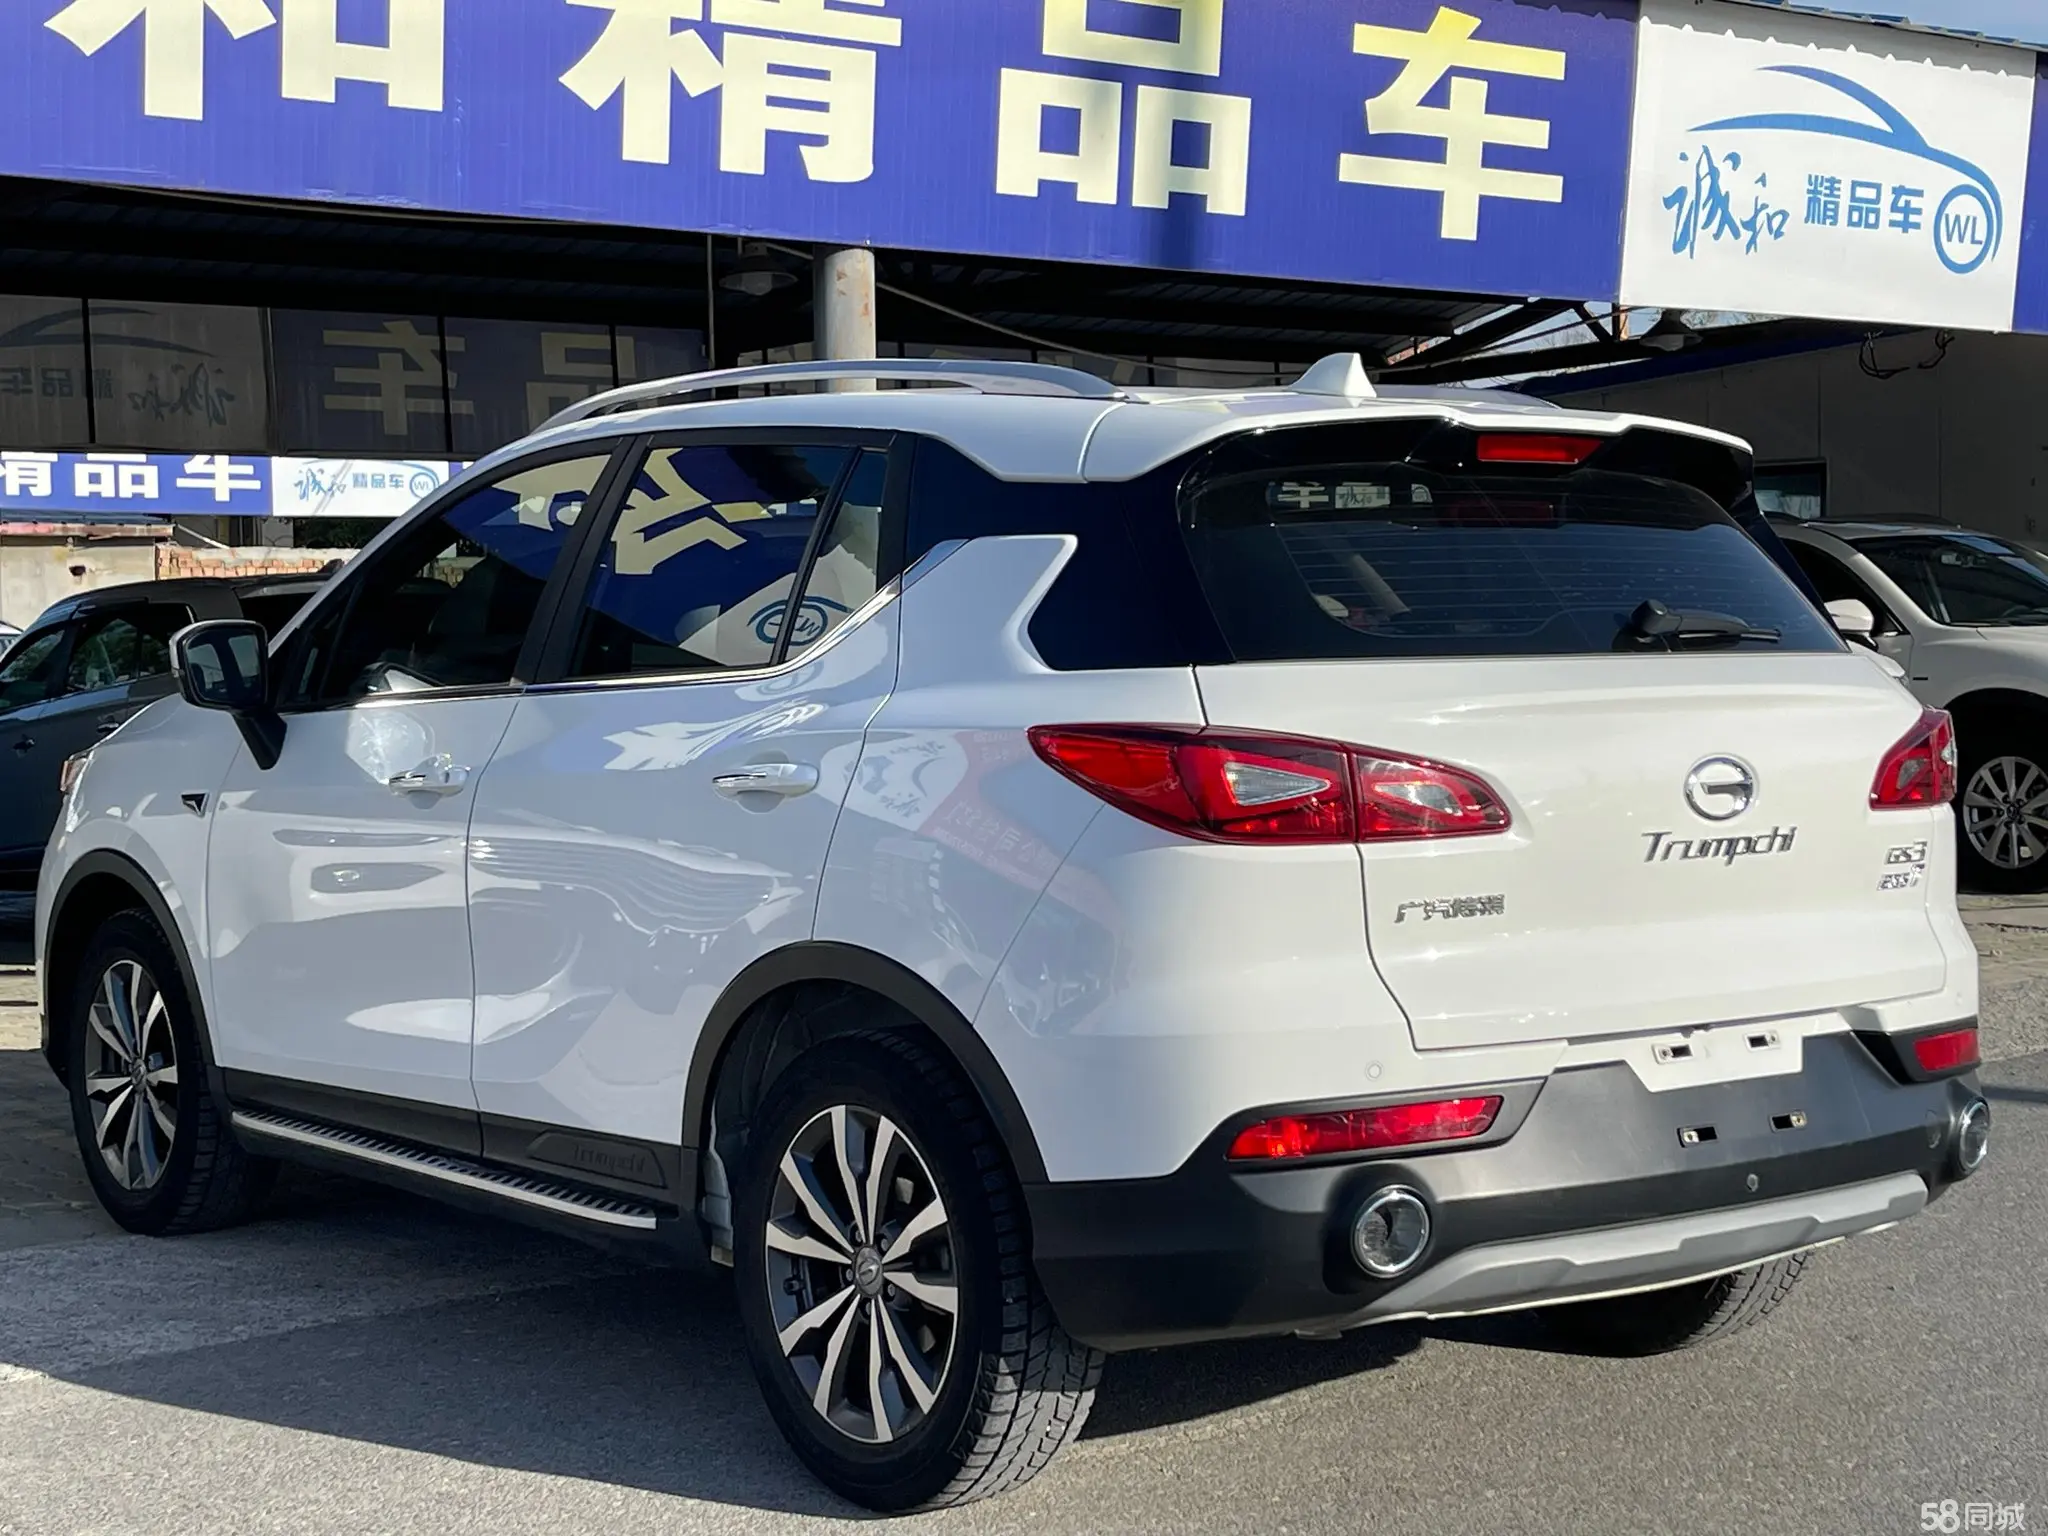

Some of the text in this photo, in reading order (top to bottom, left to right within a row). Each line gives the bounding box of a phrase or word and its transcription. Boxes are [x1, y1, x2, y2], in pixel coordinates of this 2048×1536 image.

[1804, 173, 1926, 234] 精品车
[1944, 213, 1985, 246] WL
[1641, 826, 1797, 867] Trumpchi
[1884, 841, 1928, 864] GS3
